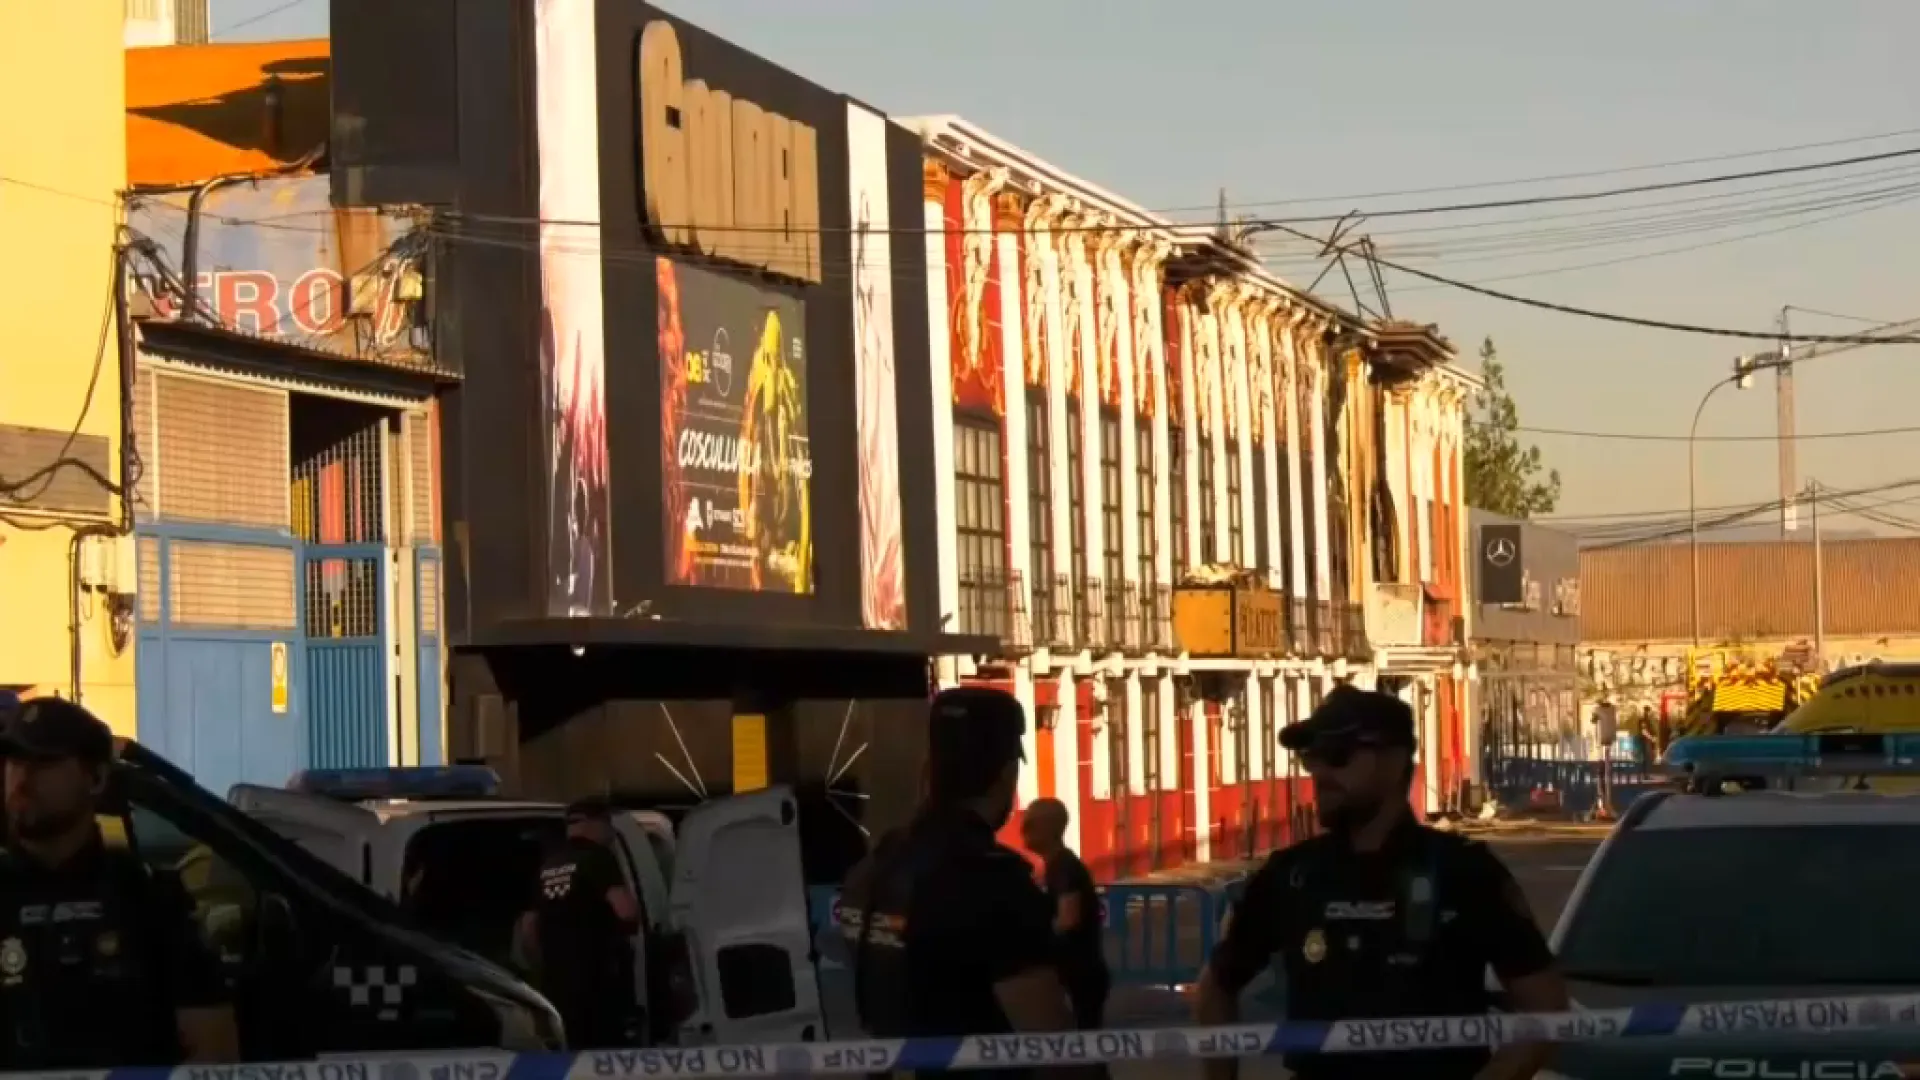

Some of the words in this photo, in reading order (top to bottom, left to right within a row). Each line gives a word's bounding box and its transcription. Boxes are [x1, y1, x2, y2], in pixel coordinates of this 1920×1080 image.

[1701, 1002, 1797, 1030] PASAR
[1808, 1000, 1849, 1026] NO
[1199, 1031, 1261, 1053] CNP
[1347, 1018, 1449, 1046] PASAR
[1459, 1017, 1501, 1043] NO
[823, 1046, 888, 1068] CNP
[977, 1033, 1086, 1061] PASAR
[1097, 1032, 1142, 1058] NO
[593, 1048, 706, 1076] PASAR
[717, 1046, 766, 1073] NO
[1668, 1057, 1907, 1080] POLICIA
